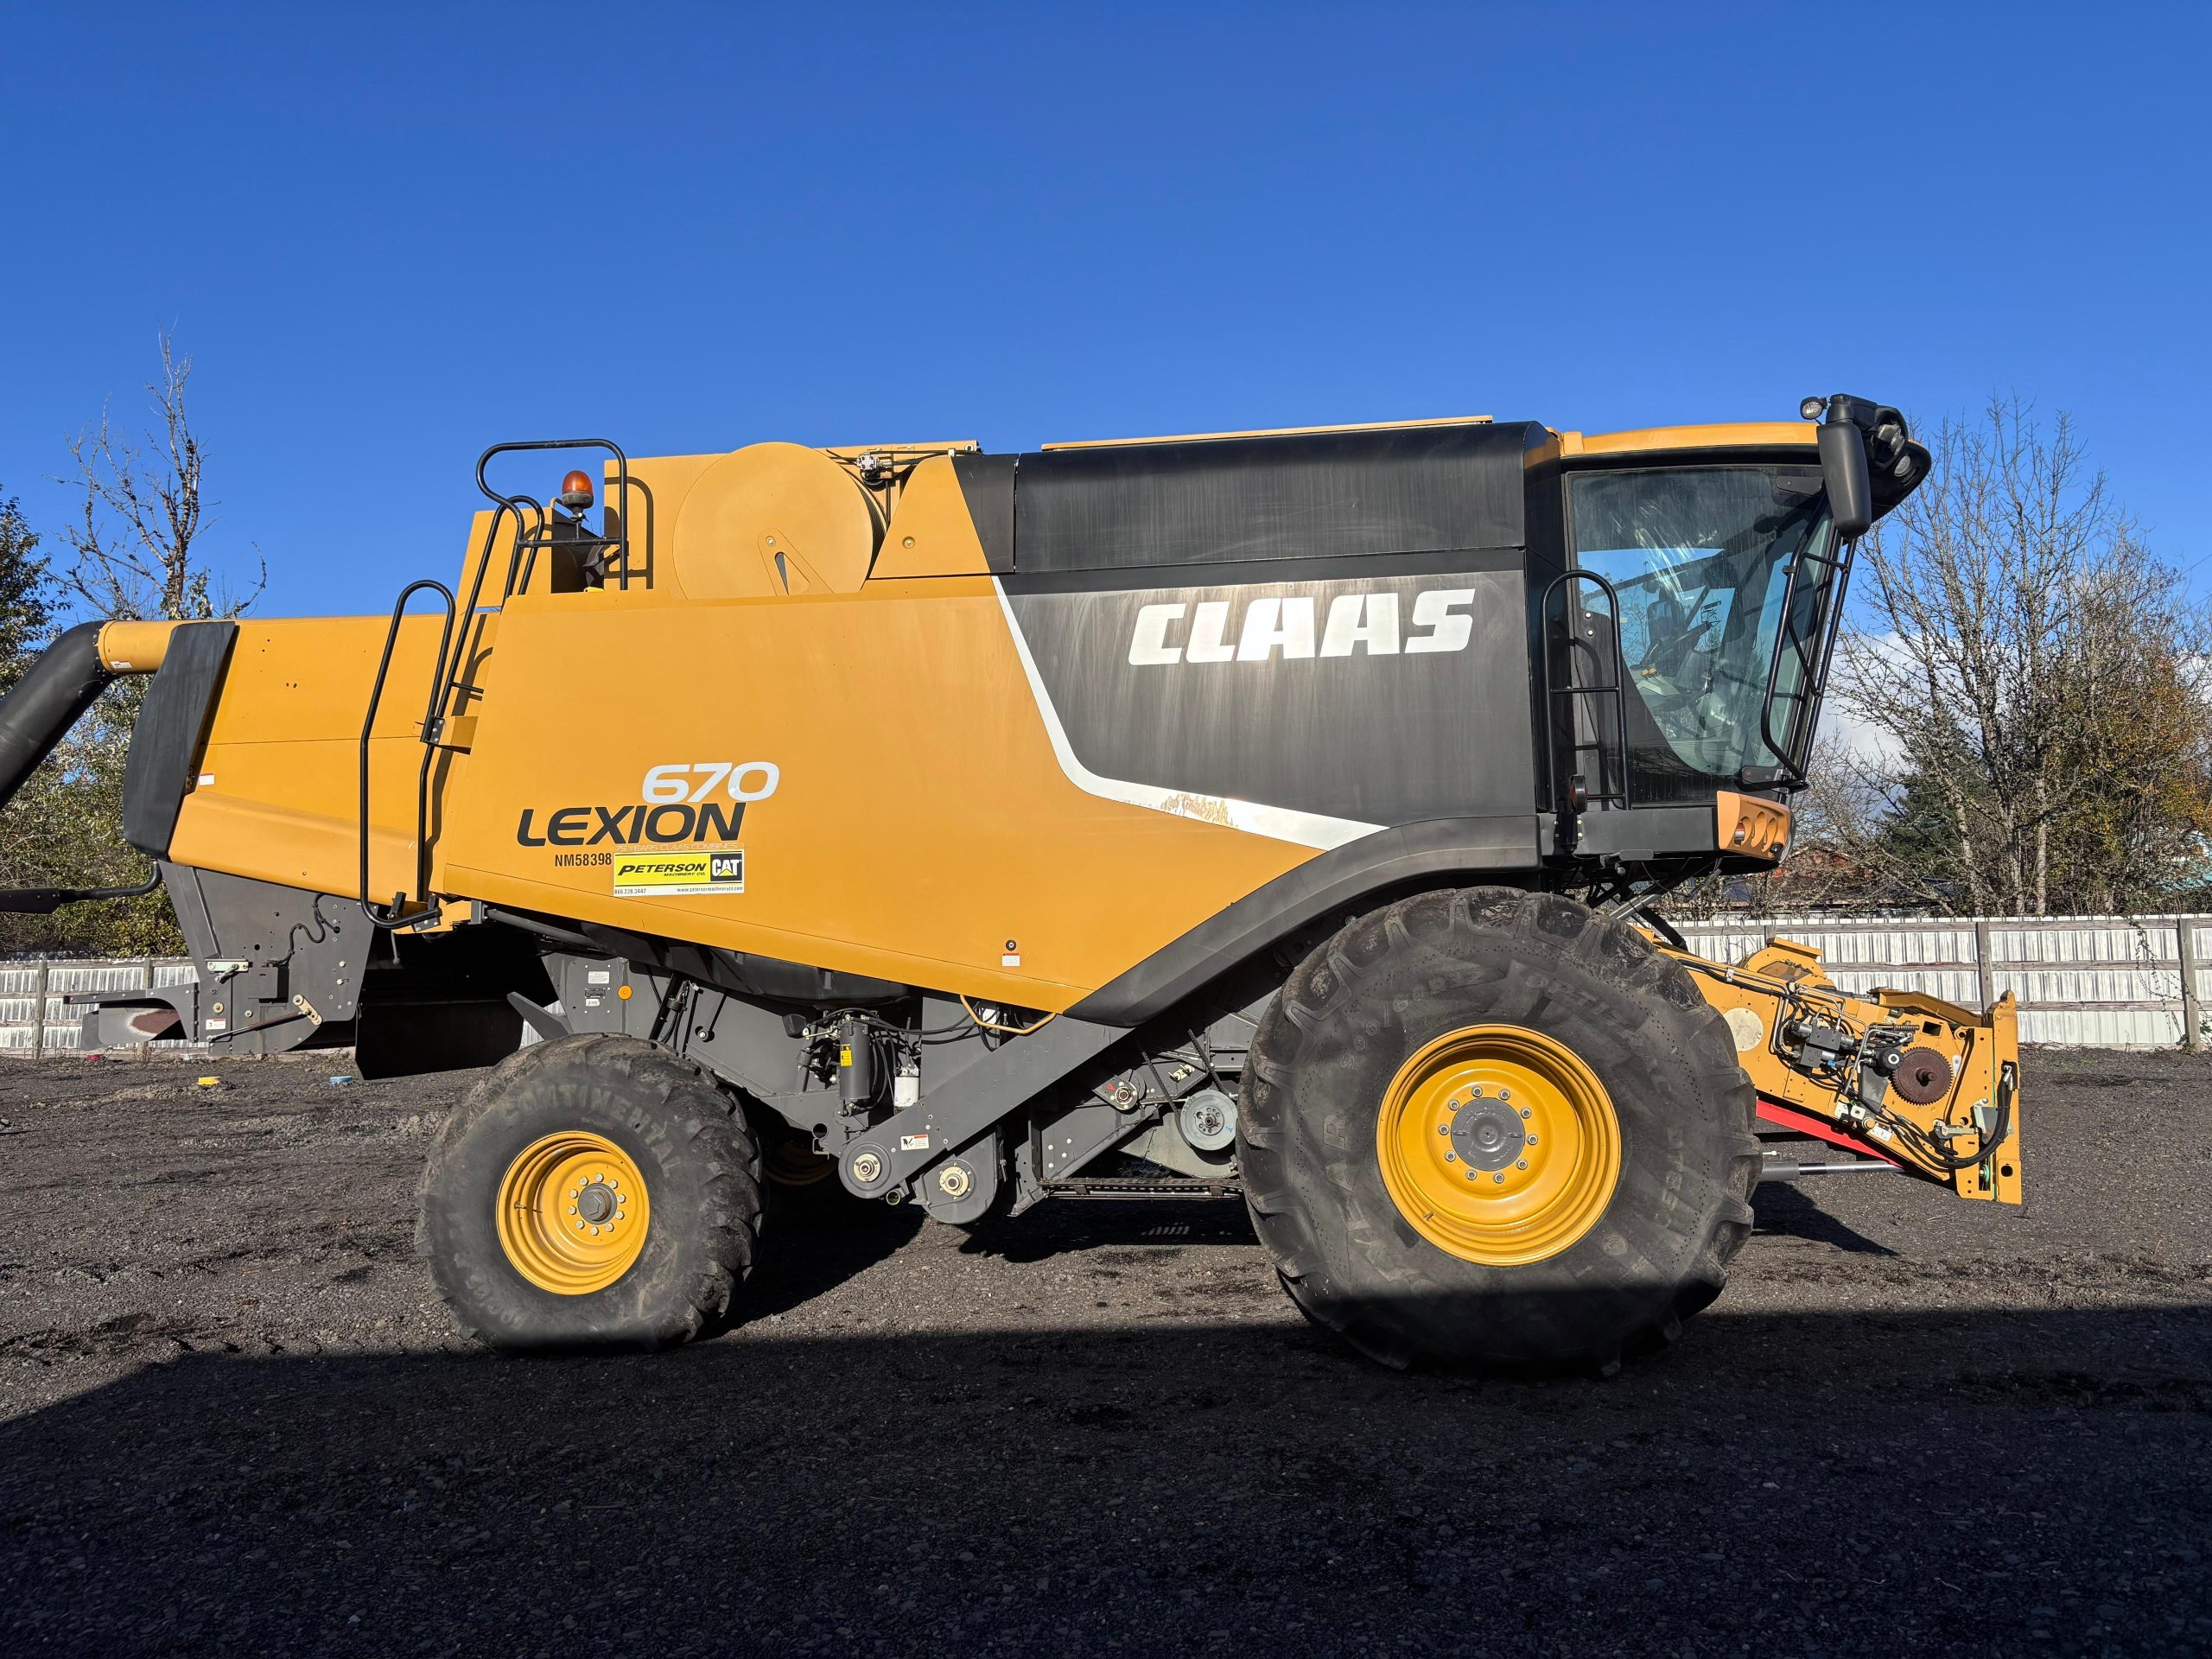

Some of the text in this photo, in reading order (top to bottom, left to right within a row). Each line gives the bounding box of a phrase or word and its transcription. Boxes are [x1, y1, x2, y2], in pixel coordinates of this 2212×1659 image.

[1128, 588, 1476, 665] CLAAS
[642, 761, 780, 804] 670
[517, 802, 747, 847] LEXION
[660, 842, 690, 851] CLAAS
[691, 842, 738, 850] COMBINES
[555, 852, 612, 868] NM58398
[617, 862, 707, 876] PETERSON
[711, 858, 740, 877] CAT
